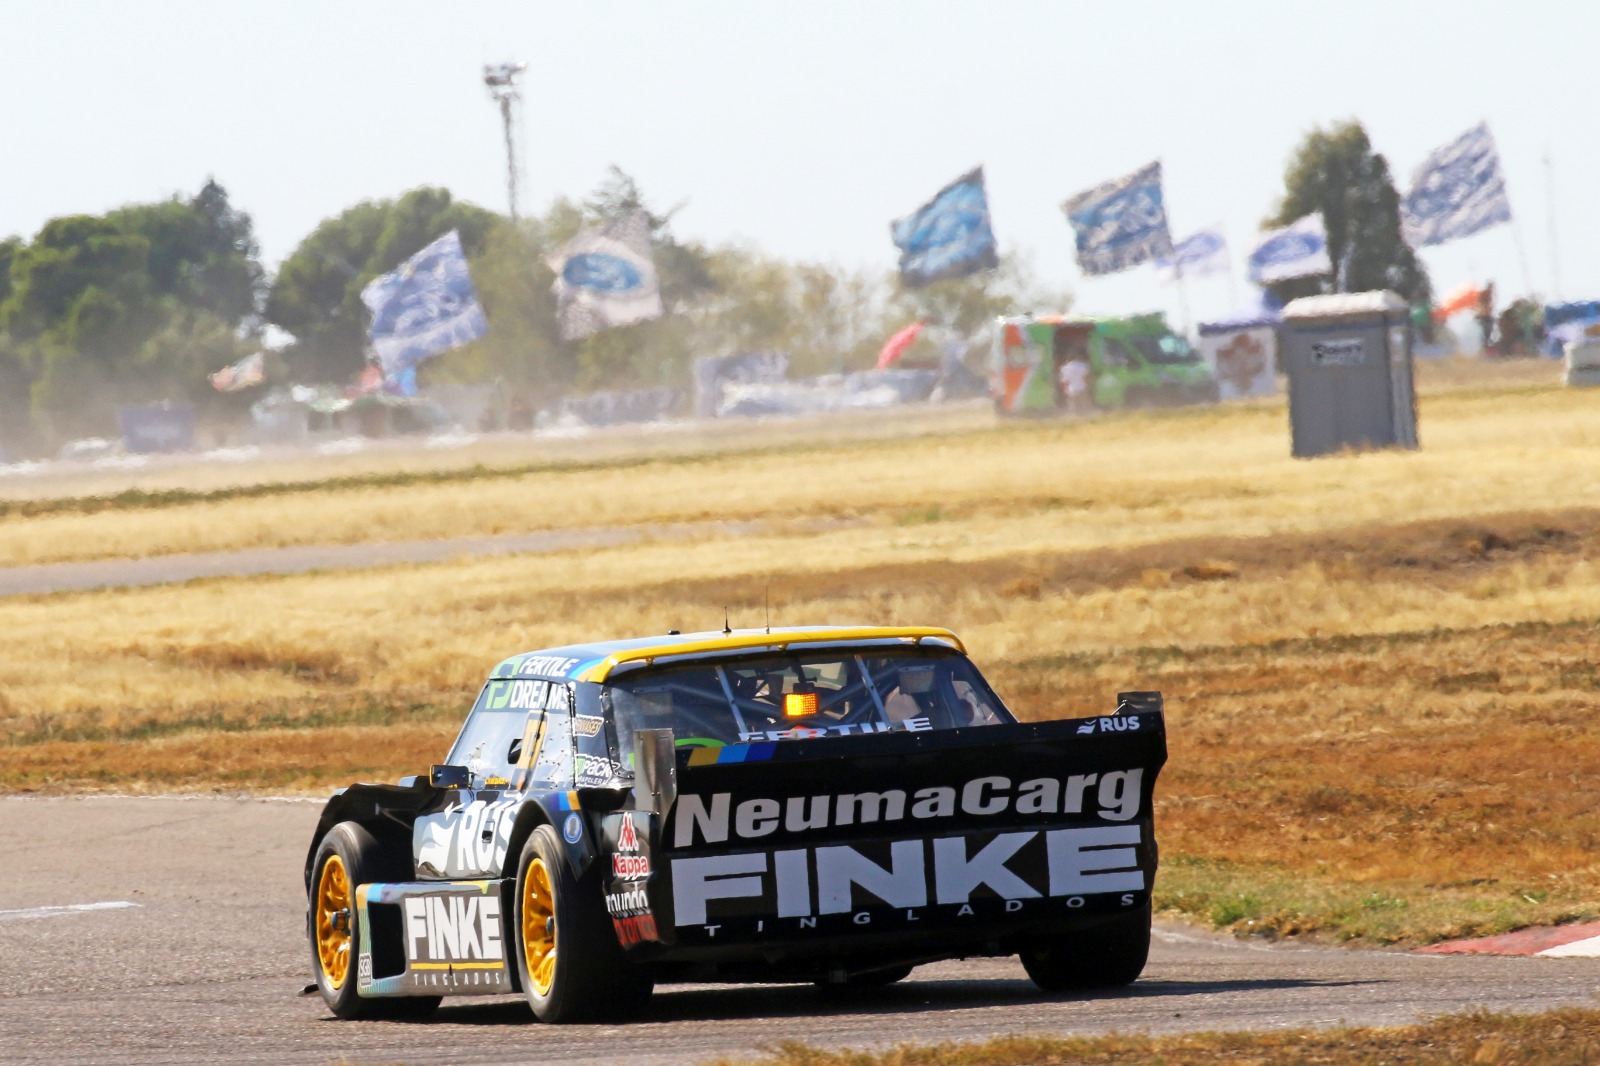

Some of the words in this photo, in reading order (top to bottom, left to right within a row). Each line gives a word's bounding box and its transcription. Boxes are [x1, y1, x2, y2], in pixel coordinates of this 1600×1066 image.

[519, 656, 580, 677] FERTILE
[509, 680, 577, 710] DREAMS
[1099, 716, 1140, 732] RUS
[673, 767, 1144, 848] NeumaCarg
[457, 800, 521, 871] RUS
[613, 853, 649, 880] Kappa
[671, 825, 1146, 927] FINKE
[404, 896, 503, 960] FINKE
[703, 893, 1135, 938] TINGLADOS
[413, 972, 501, 987] TINGLADOS
